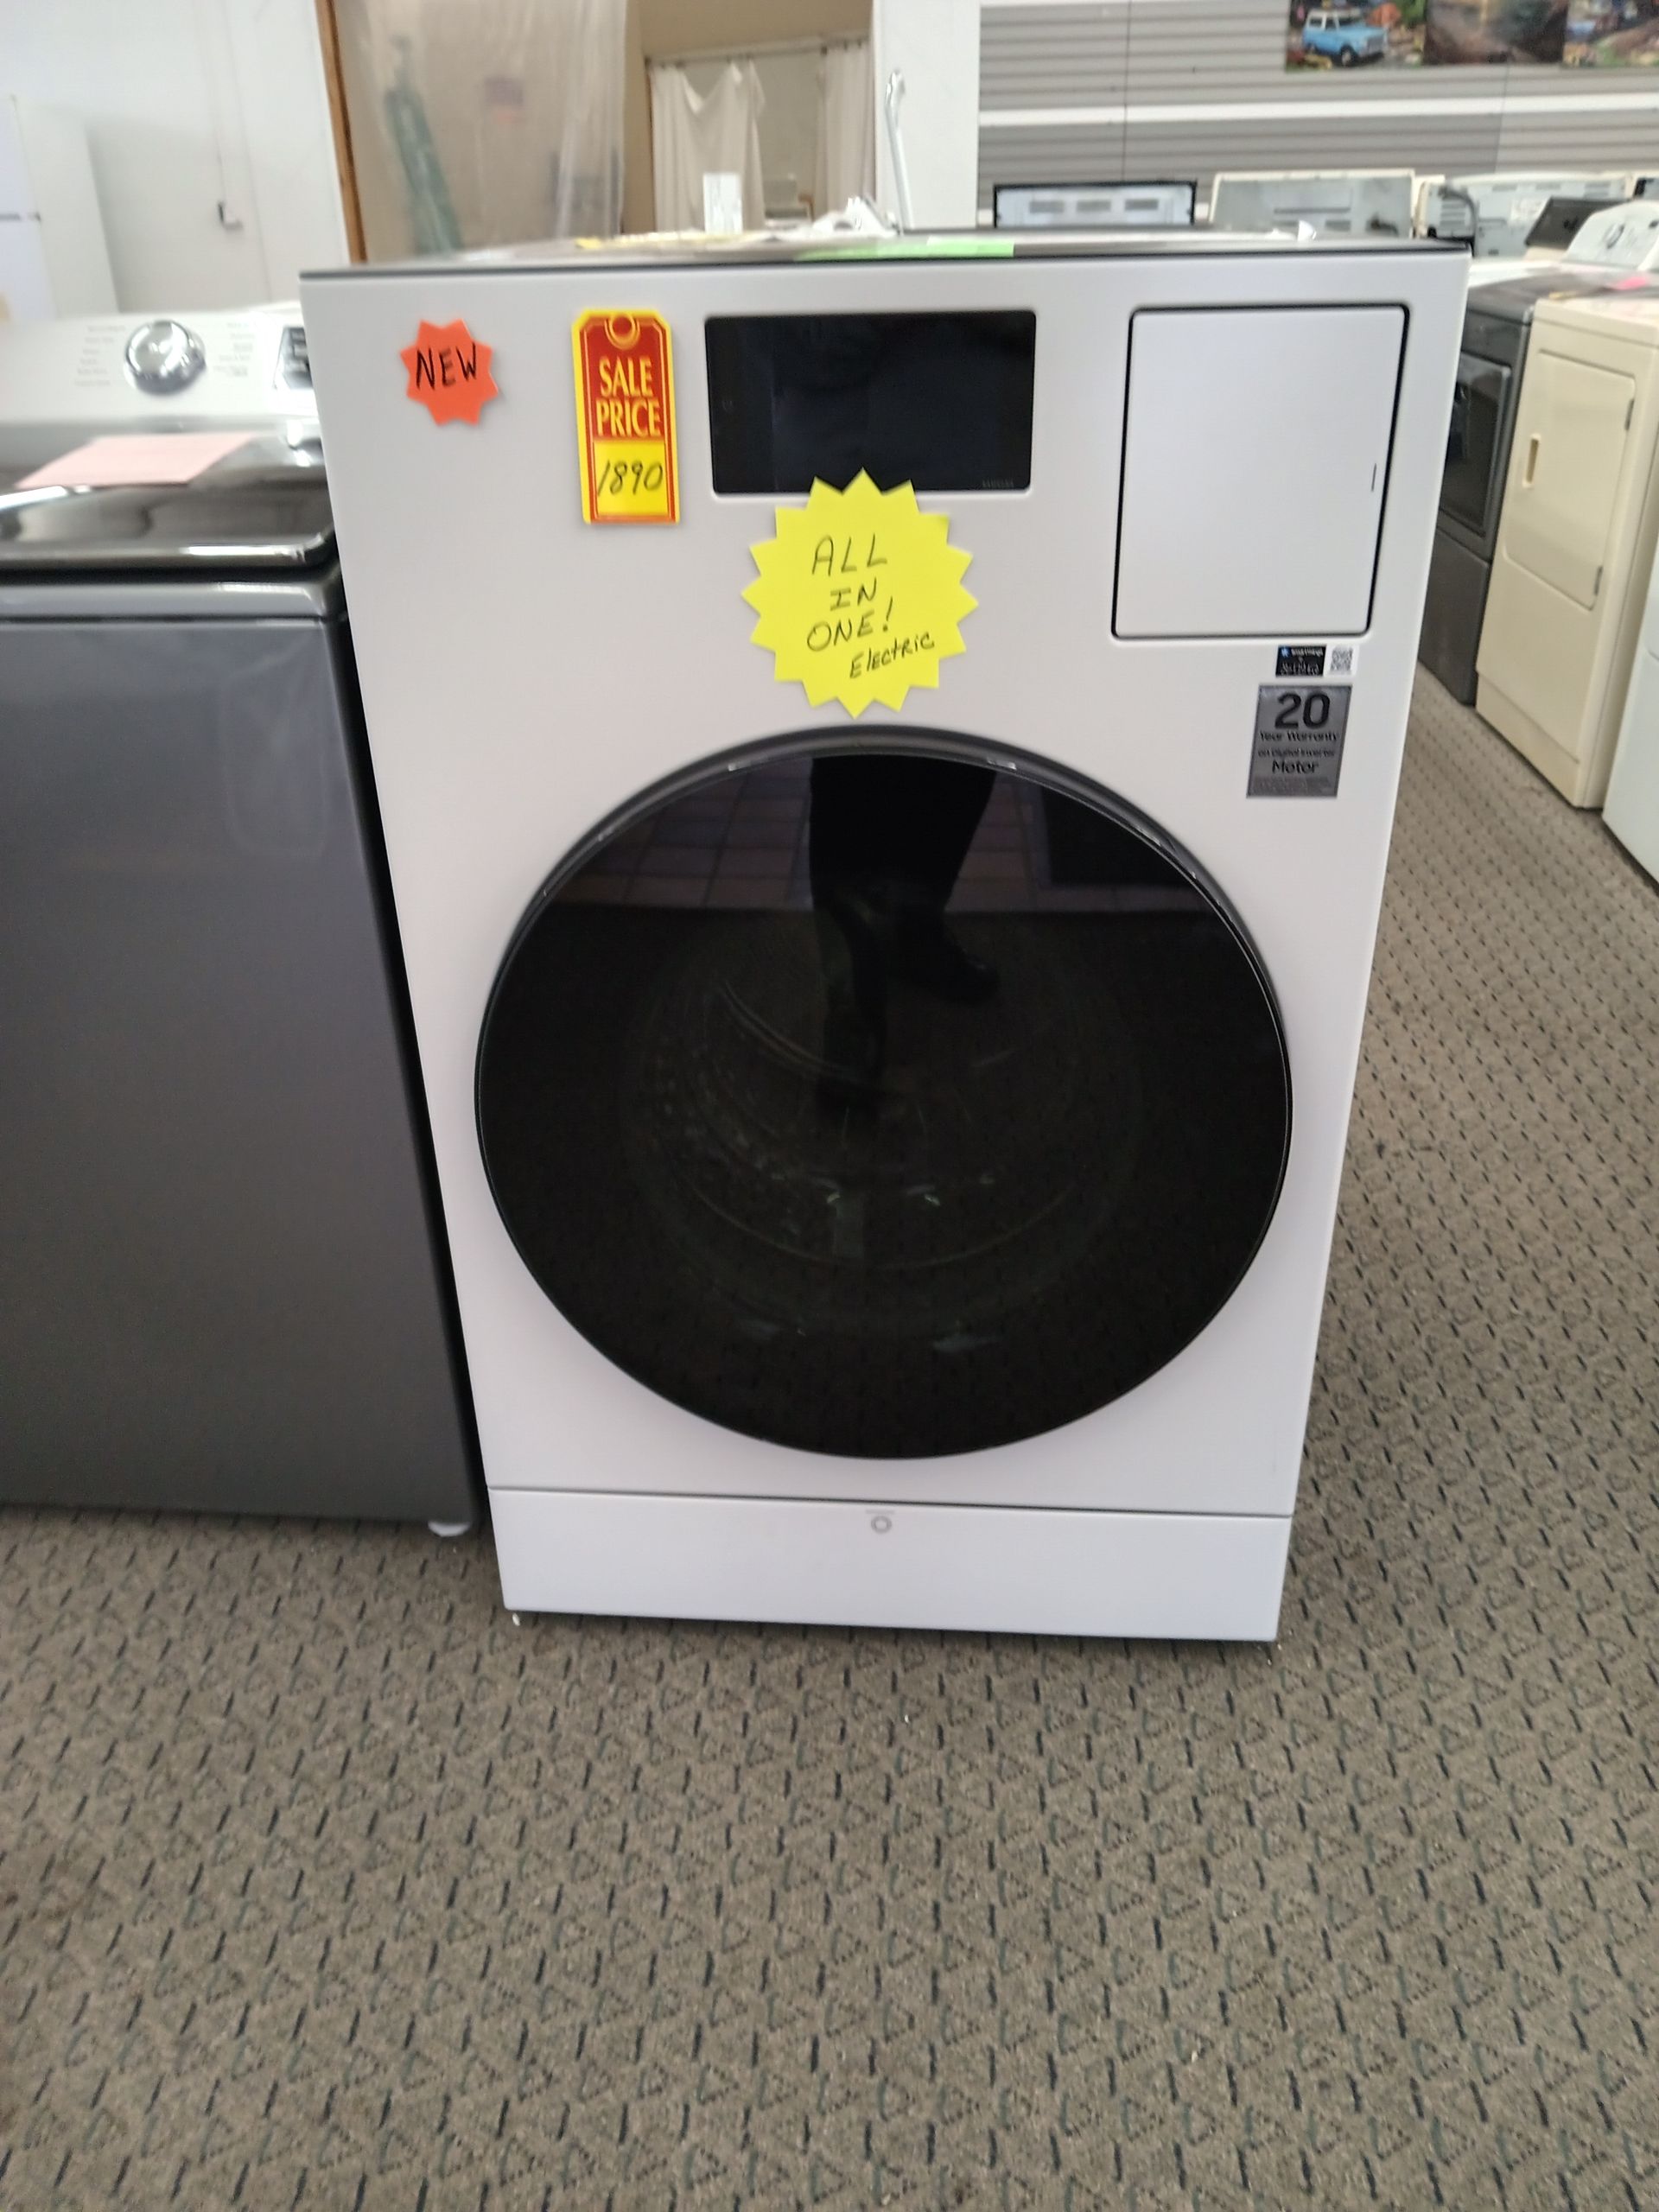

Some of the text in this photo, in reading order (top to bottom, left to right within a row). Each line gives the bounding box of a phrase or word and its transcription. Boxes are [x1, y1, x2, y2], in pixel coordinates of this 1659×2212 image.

[415, 341, 477, 391] NEW
[599, 356, 654, 397] SALE
[595, 397, 662, 438] PRICE
[597, 460, 664, 498] 1890
[811, 532, 888, 576] ALL
[830, 576, 877, 612] IN
[806, 595, 893, 652] ONE!
[1274, 692, 1331, 729] 20
[1260, 731, 1283, 742] Year
[1272, 760, 1319, 774] Motor
